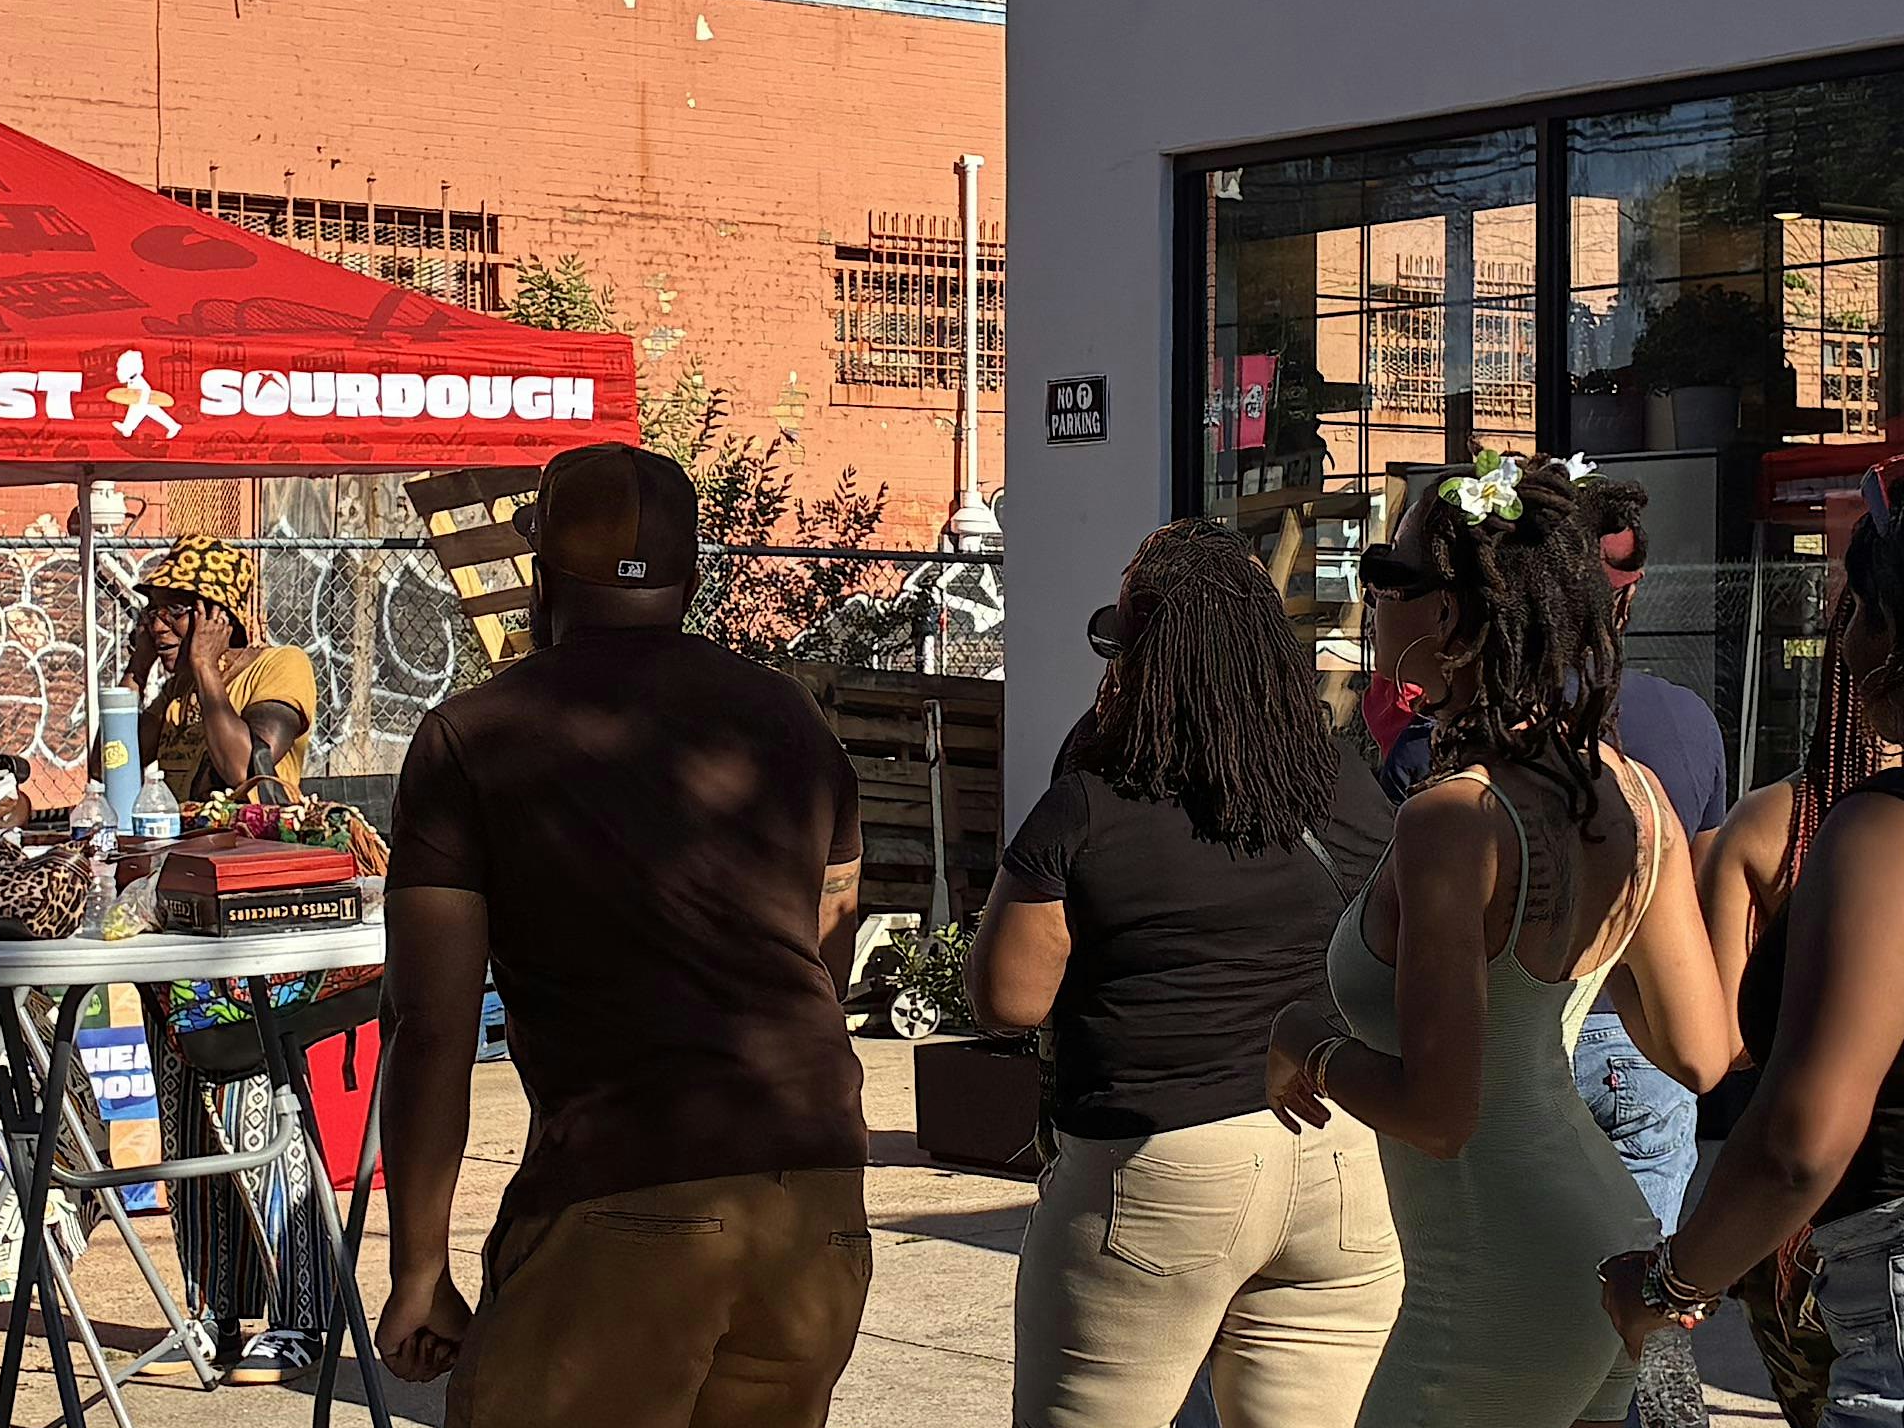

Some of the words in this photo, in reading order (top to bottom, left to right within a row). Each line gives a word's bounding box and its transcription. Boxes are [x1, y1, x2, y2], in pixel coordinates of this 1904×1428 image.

[199, 369, 595, 421] SOURDOUGH
[1057, 385, 1074, 410] NO
[1051, 411, 1101, 437] PARKING
